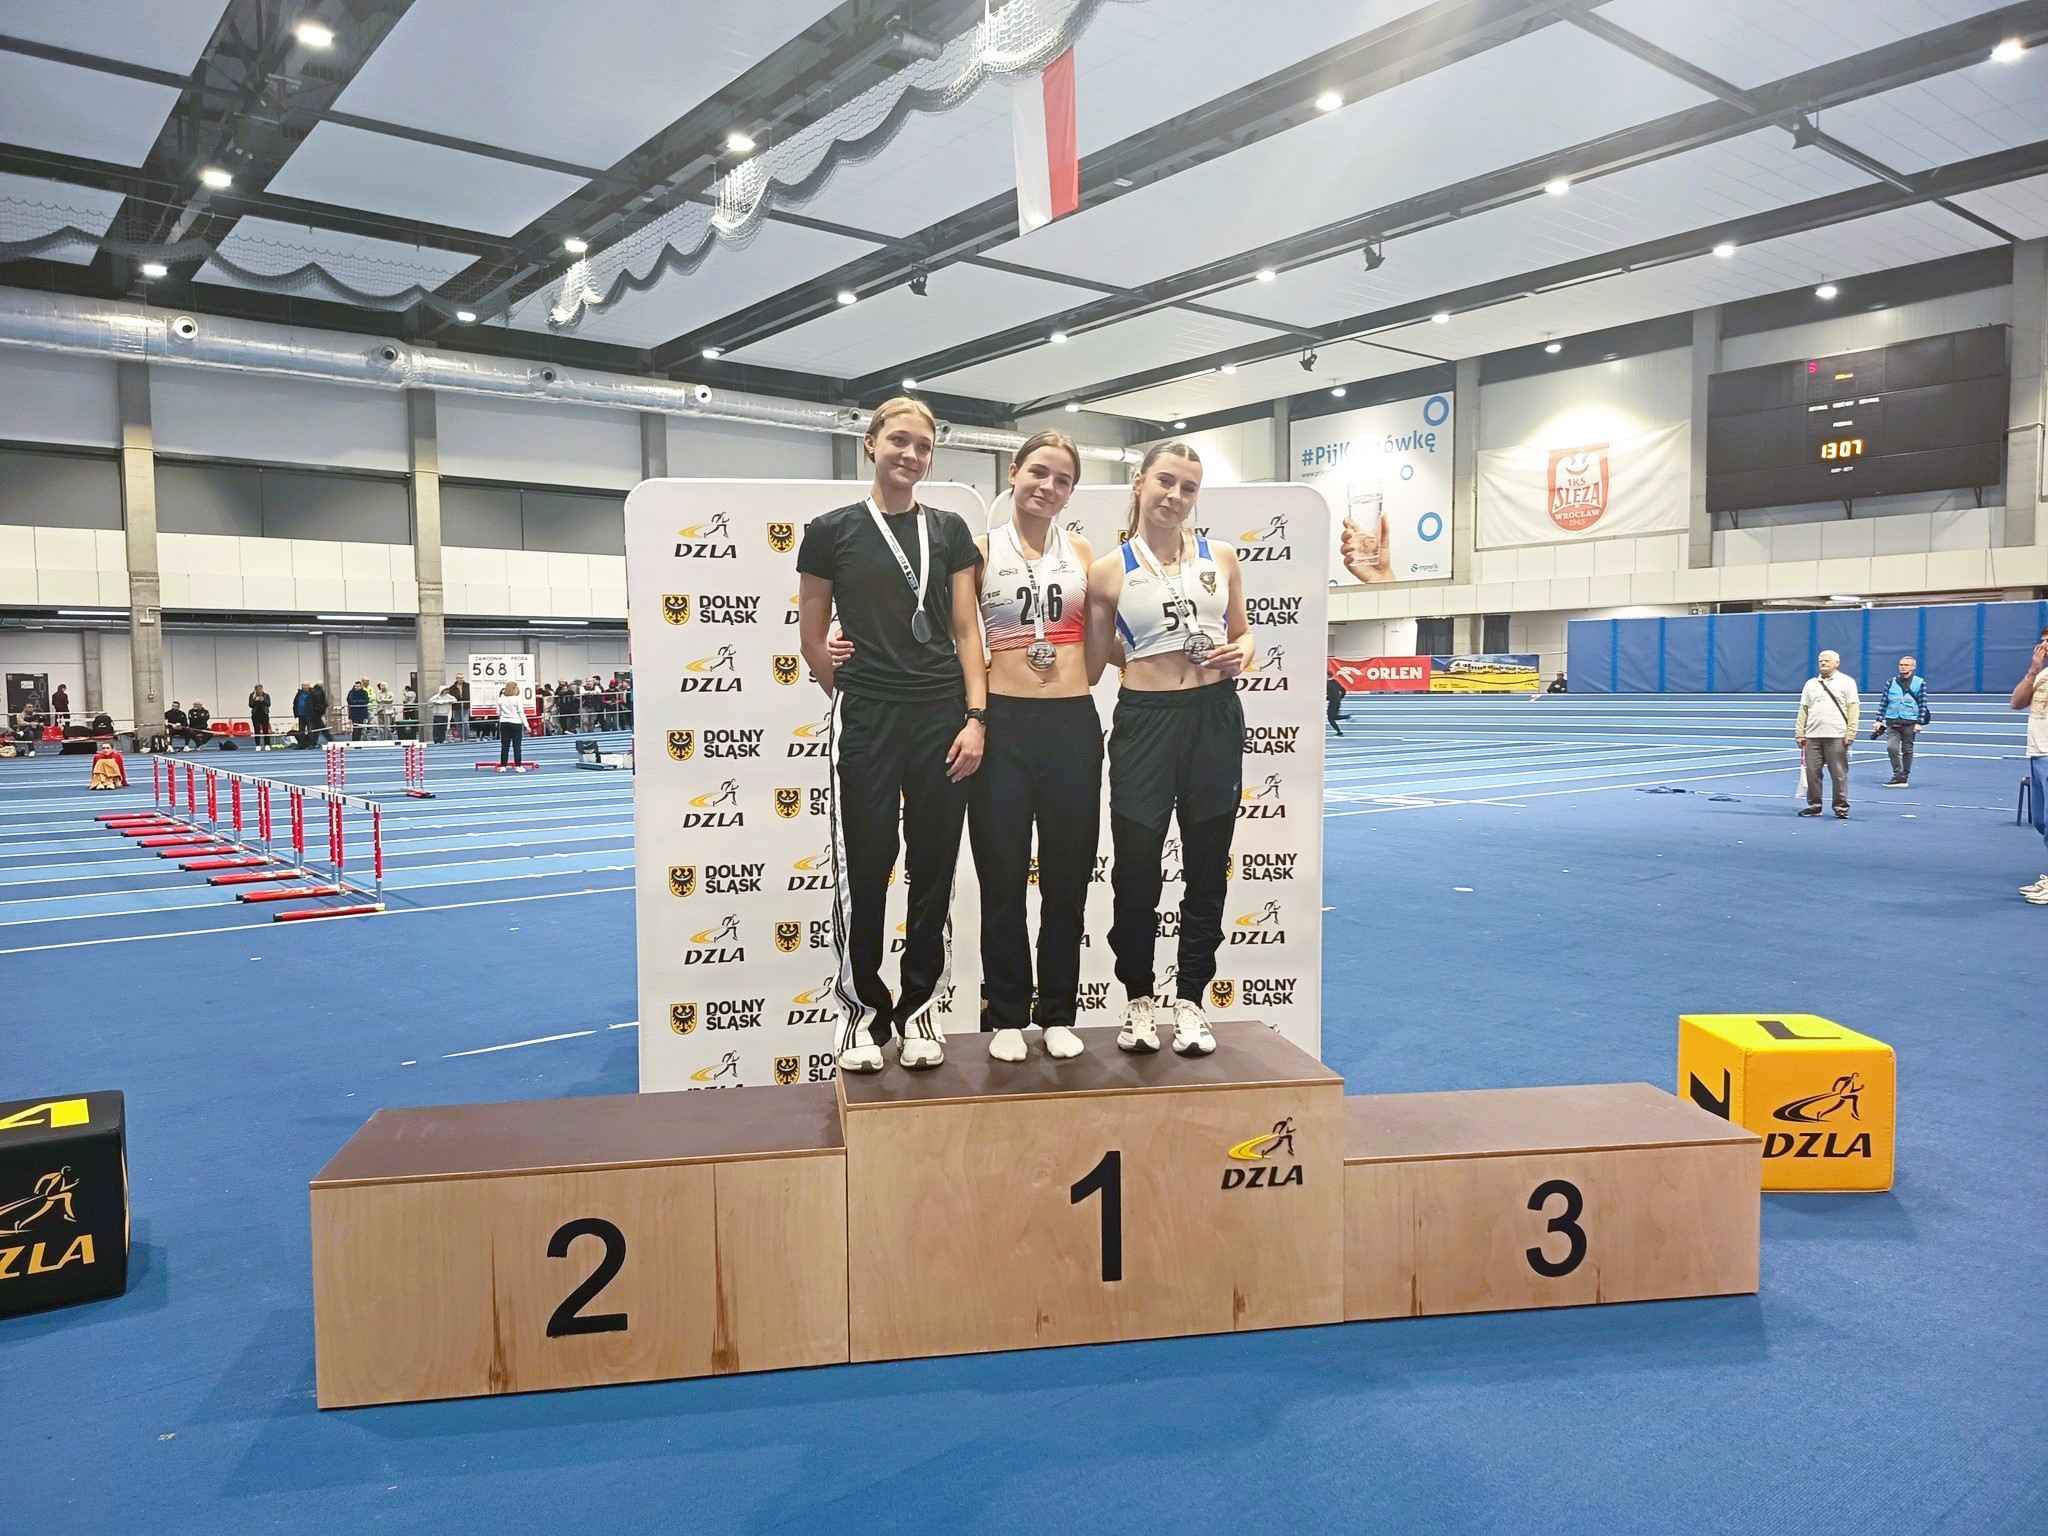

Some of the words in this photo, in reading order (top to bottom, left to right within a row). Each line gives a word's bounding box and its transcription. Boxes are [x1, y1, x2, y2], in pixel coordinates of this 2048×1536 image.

[1301, 430, 1436, 467] #PijKówkę
[674, 543, 737, 559] DZLA
[1235, 545, 1291, 562] DZLA
[699, 595, 761, 609] DOLNY
[1016, 583, 1063, 626] 26
[1246, 596, 1303, 611] DOLNY
[699, 606, 758, 626] ŚLĄSK
[1247, 609, 1299, 627] ŚLĄSK
[472, 662, 507, 676] 568
[518, 662, 524, 676] 1
[1366, 665, 1423, 681] ORLEN
[680, 677, 742, 693] DZLA
[1234, 676, 1289, 692] DZLA
[703, 729, 765, 744] DOLNY
[1245, 726, 1300, 740] DOLNY
[703, 741, 761, 760] ŚLĄSK
[787, 743, 830, 758] DZL
[1243, 738, 1296, 756] ŚLĄSK
[683, 812, 744, 828] DZLA
[1242, 853, 1298, 867] DOLNY
[705, 863, 766, 878] DOLNY
[1242, 864, 1294, 883] ŚLĄSK
[705, 875, 762, 895] ŚLĄSK
[787, 875, 836, 891] DZL
[1230, 930, 1286, 945] DZLA
[684, 947, 745, 965] DZLA
[1079, 982, 1110, 997] LNY
[1242, 978, 1297, 992] DOLNY
[1077, 996, 1107, 1012] ĄSK
[1242, 989, 1294, 1007] ŚLĄSK
[706, 998, 766, 1016] DOLNY
[706, 1012, 762, 1031] ŚLĄSK
[787, 1008, 838, 1026] DZL
[1762, 1132, 1872, 1158] DZLA
[1221, 1165, 1303, 1189] DZLA
[1070, 1150, 1123, 1283] 1
[1525, 1179, 1587, 1278] 3
[0, 1234, 96, 1280] ZLA
[545, 1217, 629, 1339] 2
